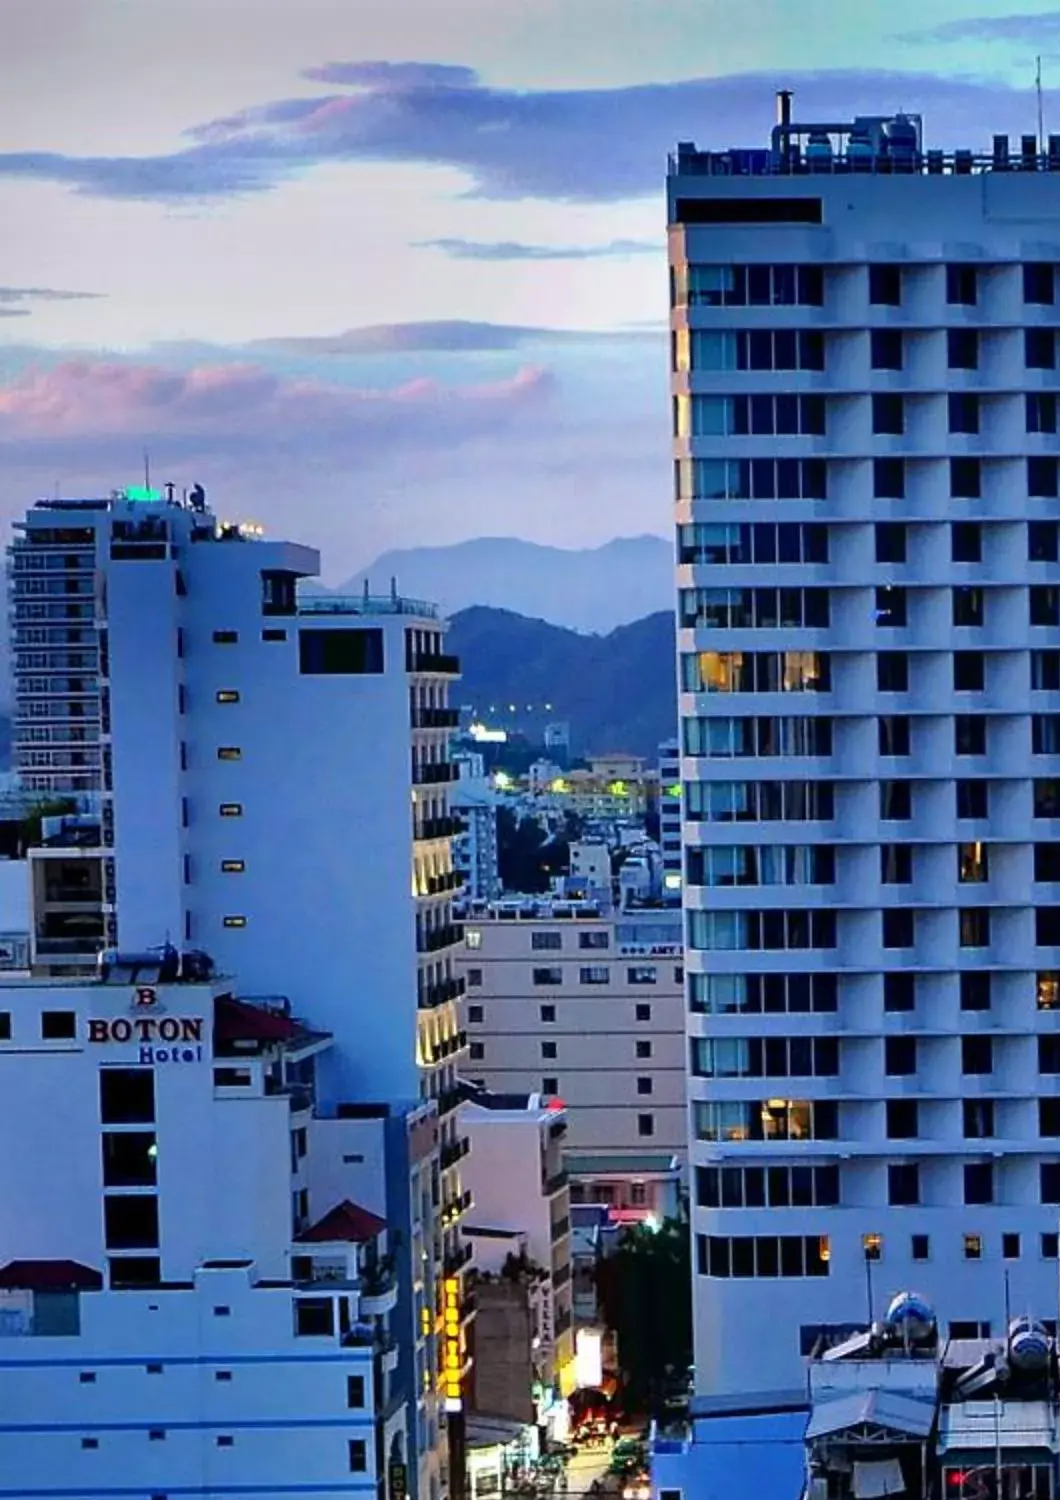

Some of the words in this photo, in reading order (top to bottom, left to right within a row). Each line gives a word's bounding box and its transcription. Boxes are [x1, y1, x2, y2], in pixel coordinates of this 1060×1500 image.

[136, 988, 156, 1005] B
[88, 1018, 203, 1042] BOTON
[139, 1046, 201, 1064] Hotel
